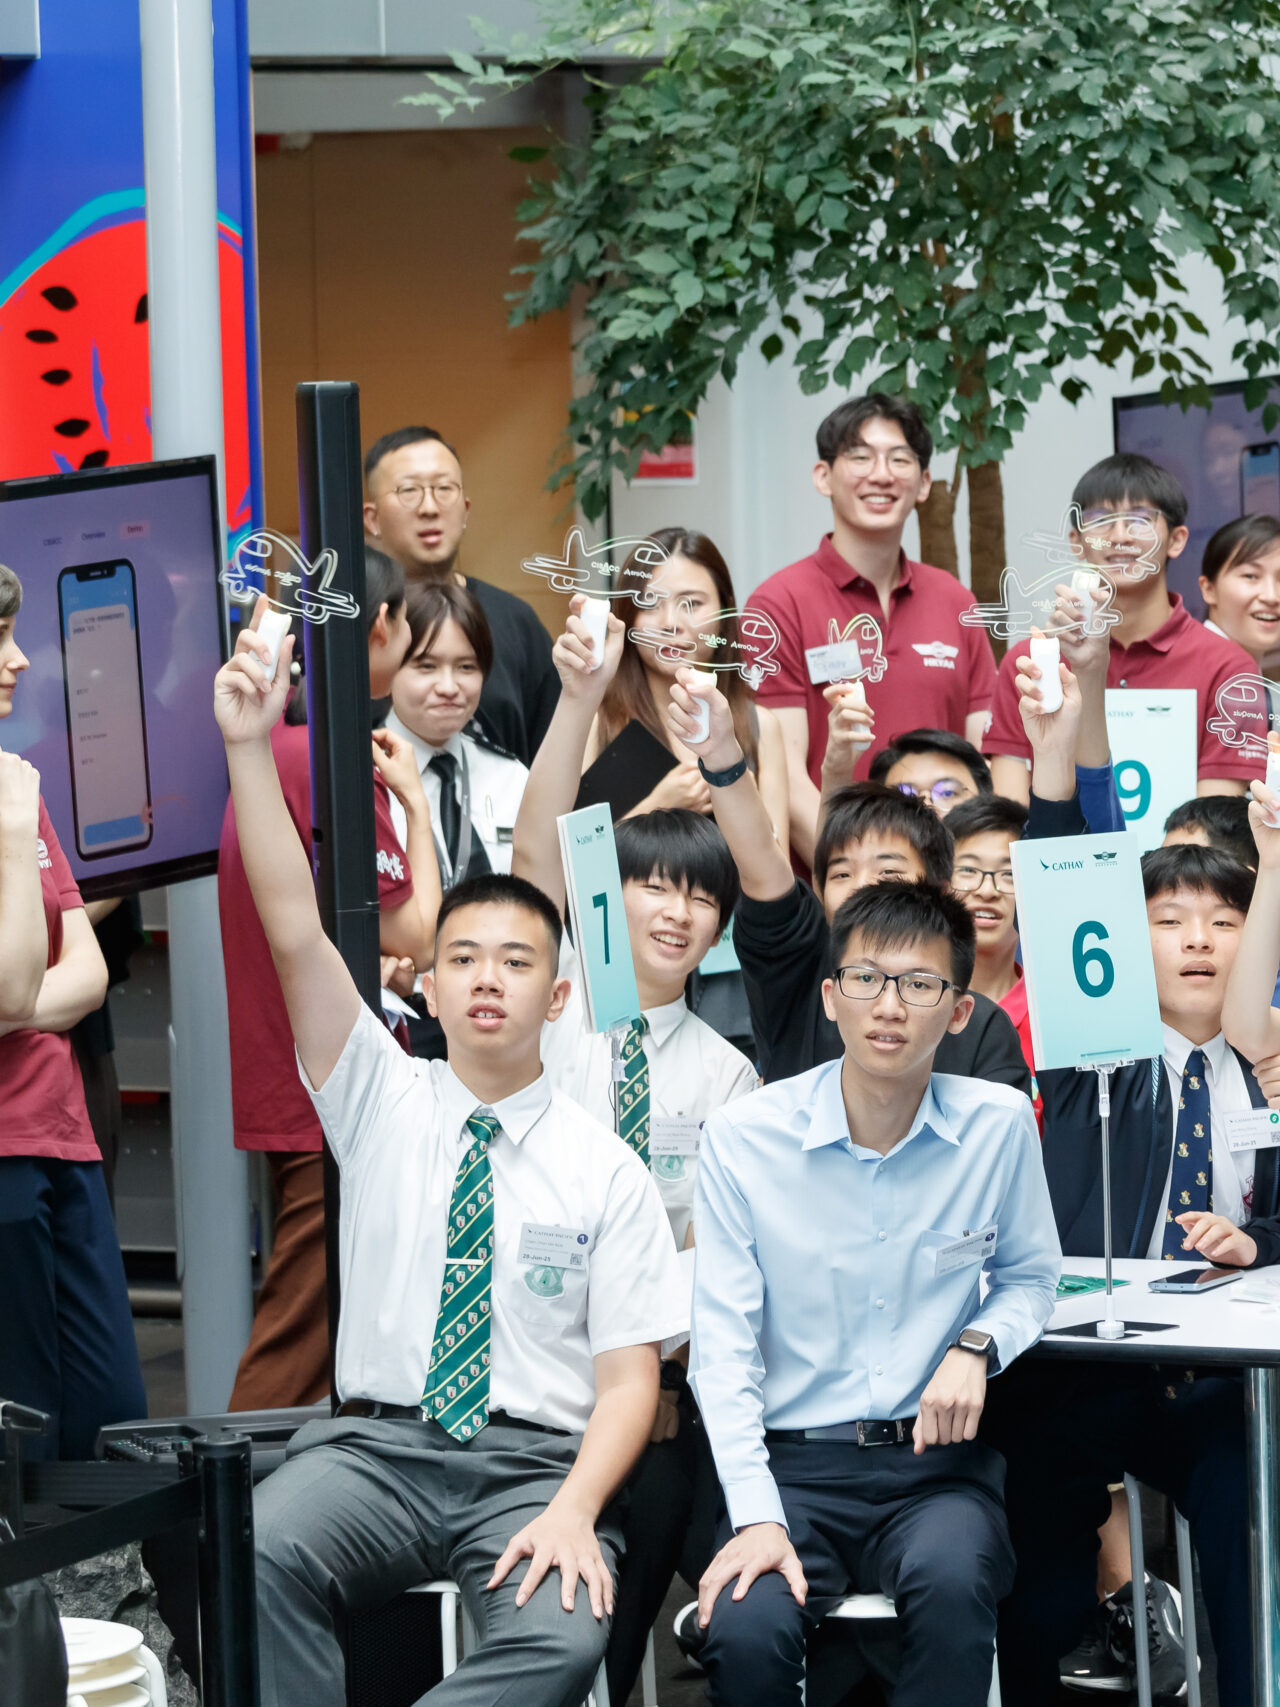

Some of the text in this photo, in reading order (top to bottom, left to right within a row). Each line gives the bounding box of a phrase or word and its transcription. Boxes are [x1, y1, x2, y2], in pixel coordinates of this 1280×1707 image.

[1113, 759, 1152, 821] 9
[1052, 860, 1084, 871] CATHAY
[1072, 920, 1115, 998] 6
